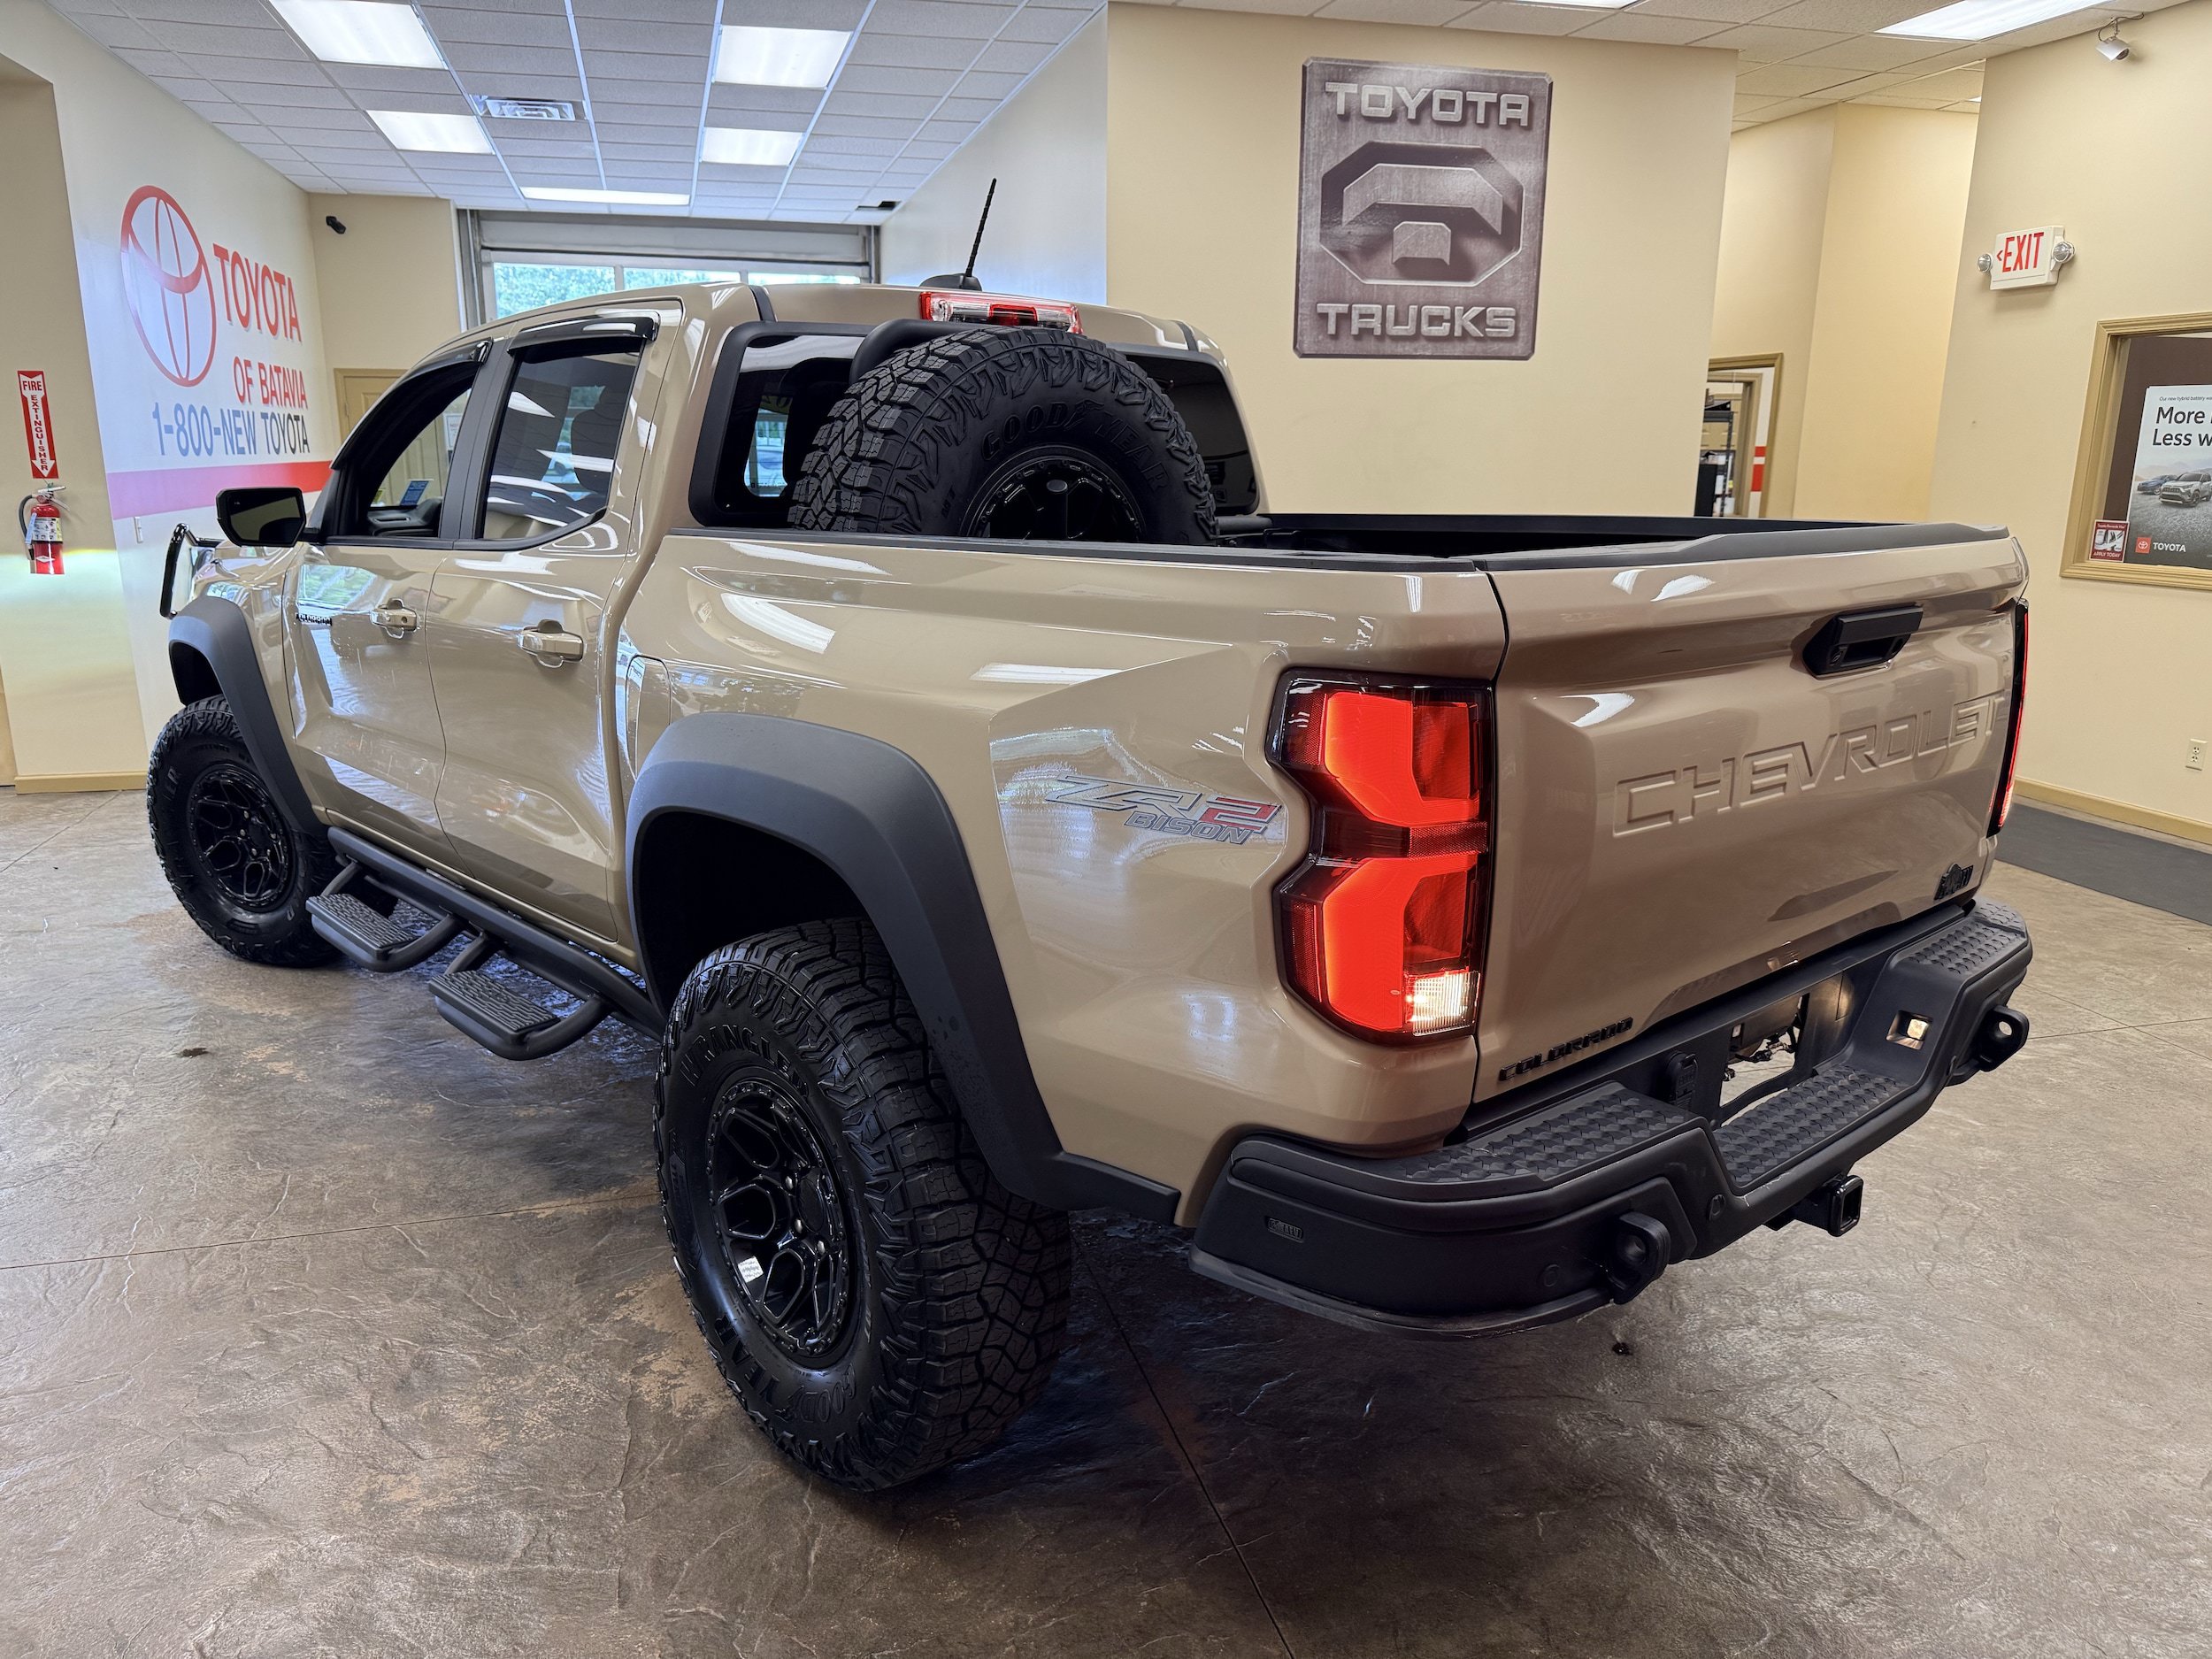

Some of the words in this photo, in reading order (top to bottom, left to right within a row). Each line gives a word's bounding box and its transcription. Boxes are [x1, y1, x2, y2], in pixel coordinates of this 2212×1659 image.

[1325, 81, 1530, 127] TOYOTA
[2002, 232, 2044, 273] EXIT
[212, 242, 303, 342] TOYOTA
[1317, 303, 1517, 338] TRUCKS
[22, 380, 42, 391] FIRE
[234, 356, 255, 403] OF
[259, 361, 308, 409] BATAVIA
[30, 395, 49, 471] EXTINGUISHER
[152, 402, 257, 457] 1-800-NEW
[261, 412, 311, 455] TOYOTA
[2153, 428, 2193, 446] Less
[2156, 406, 2205, 424] More
[2153, 541, 2186, 552] TOYOTA
[1613, 688, 2006, 837] CHEVROLET
[1045, 774, 1282, 834] ZR2
[1124, 810, 1254, 845] BISON
[1498, 1017, 1633, 1081] COLORADO
